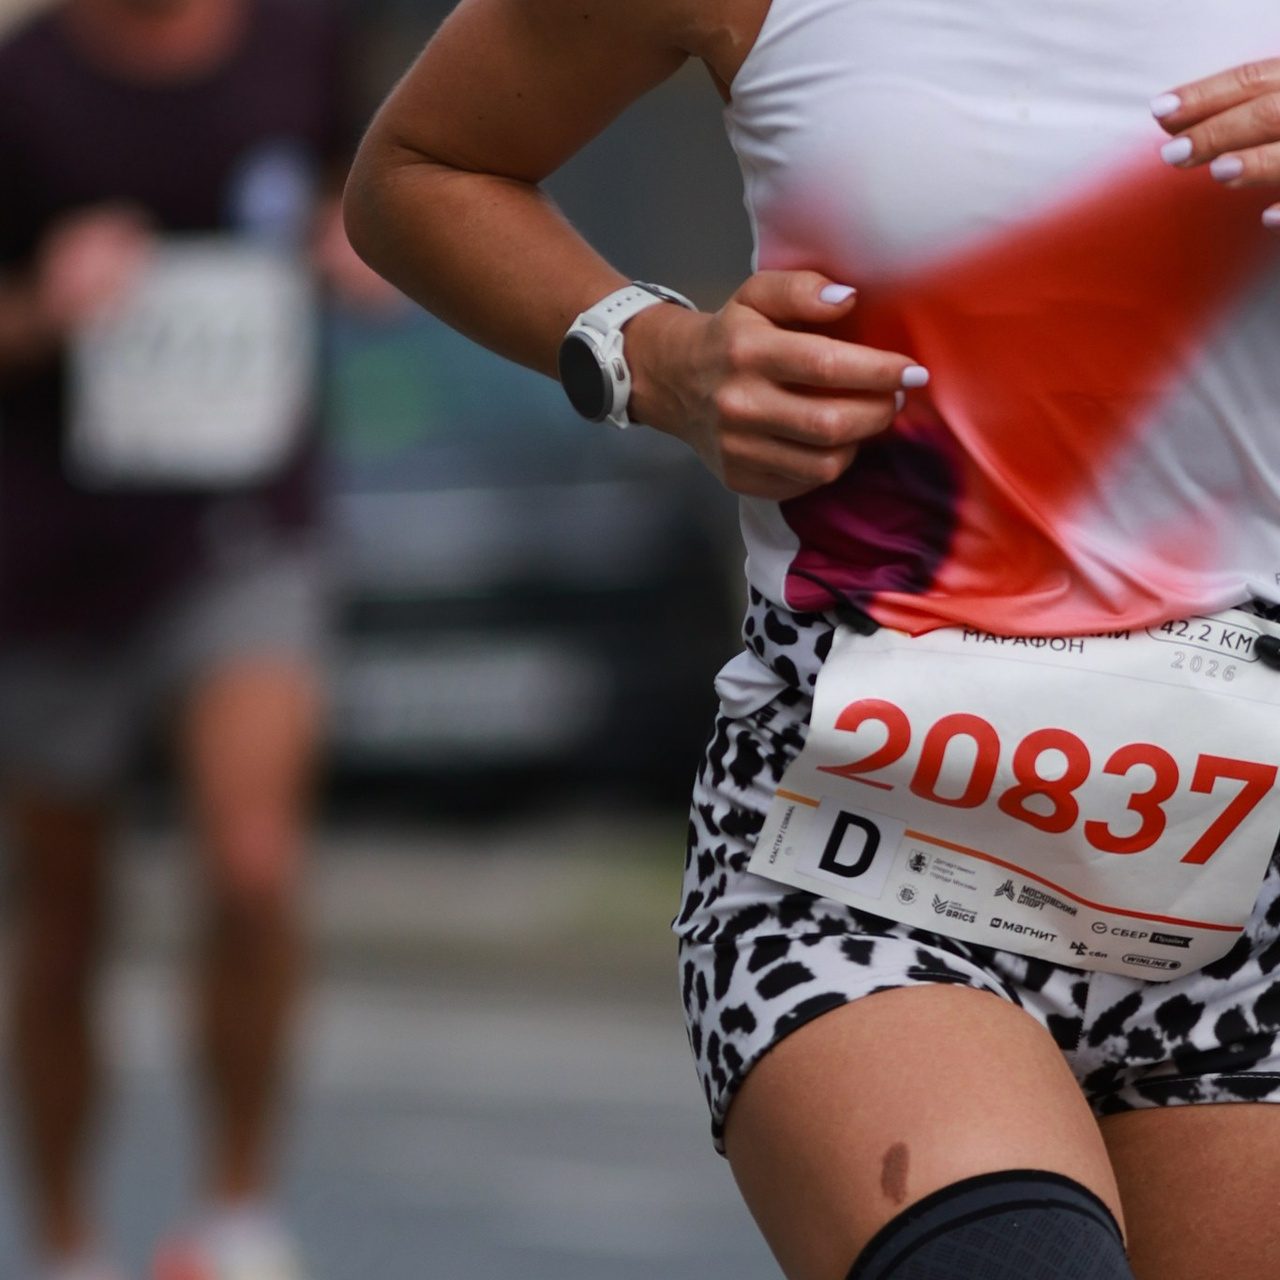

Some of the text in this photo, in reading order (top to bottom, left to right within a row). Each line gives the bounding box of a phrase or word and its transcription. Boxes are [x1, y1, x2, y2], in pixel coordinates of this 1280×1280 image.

[1160, 619, 1212, 642] 42,2
[1170, 650, 1237, 682] 2026
[815, 698, 1279, 866] 20837
[818, 810, 881, 878] D
[1017, 894, 1046, 911] СПОРТ
[1021, 885, 1078, 917] МОСКОВСКИЙ
[945, 909, 976, 923] BRICS
[1111, 927, 1149, 940] СБЕР
[1127, 956, 1168, 968] WINLINE
